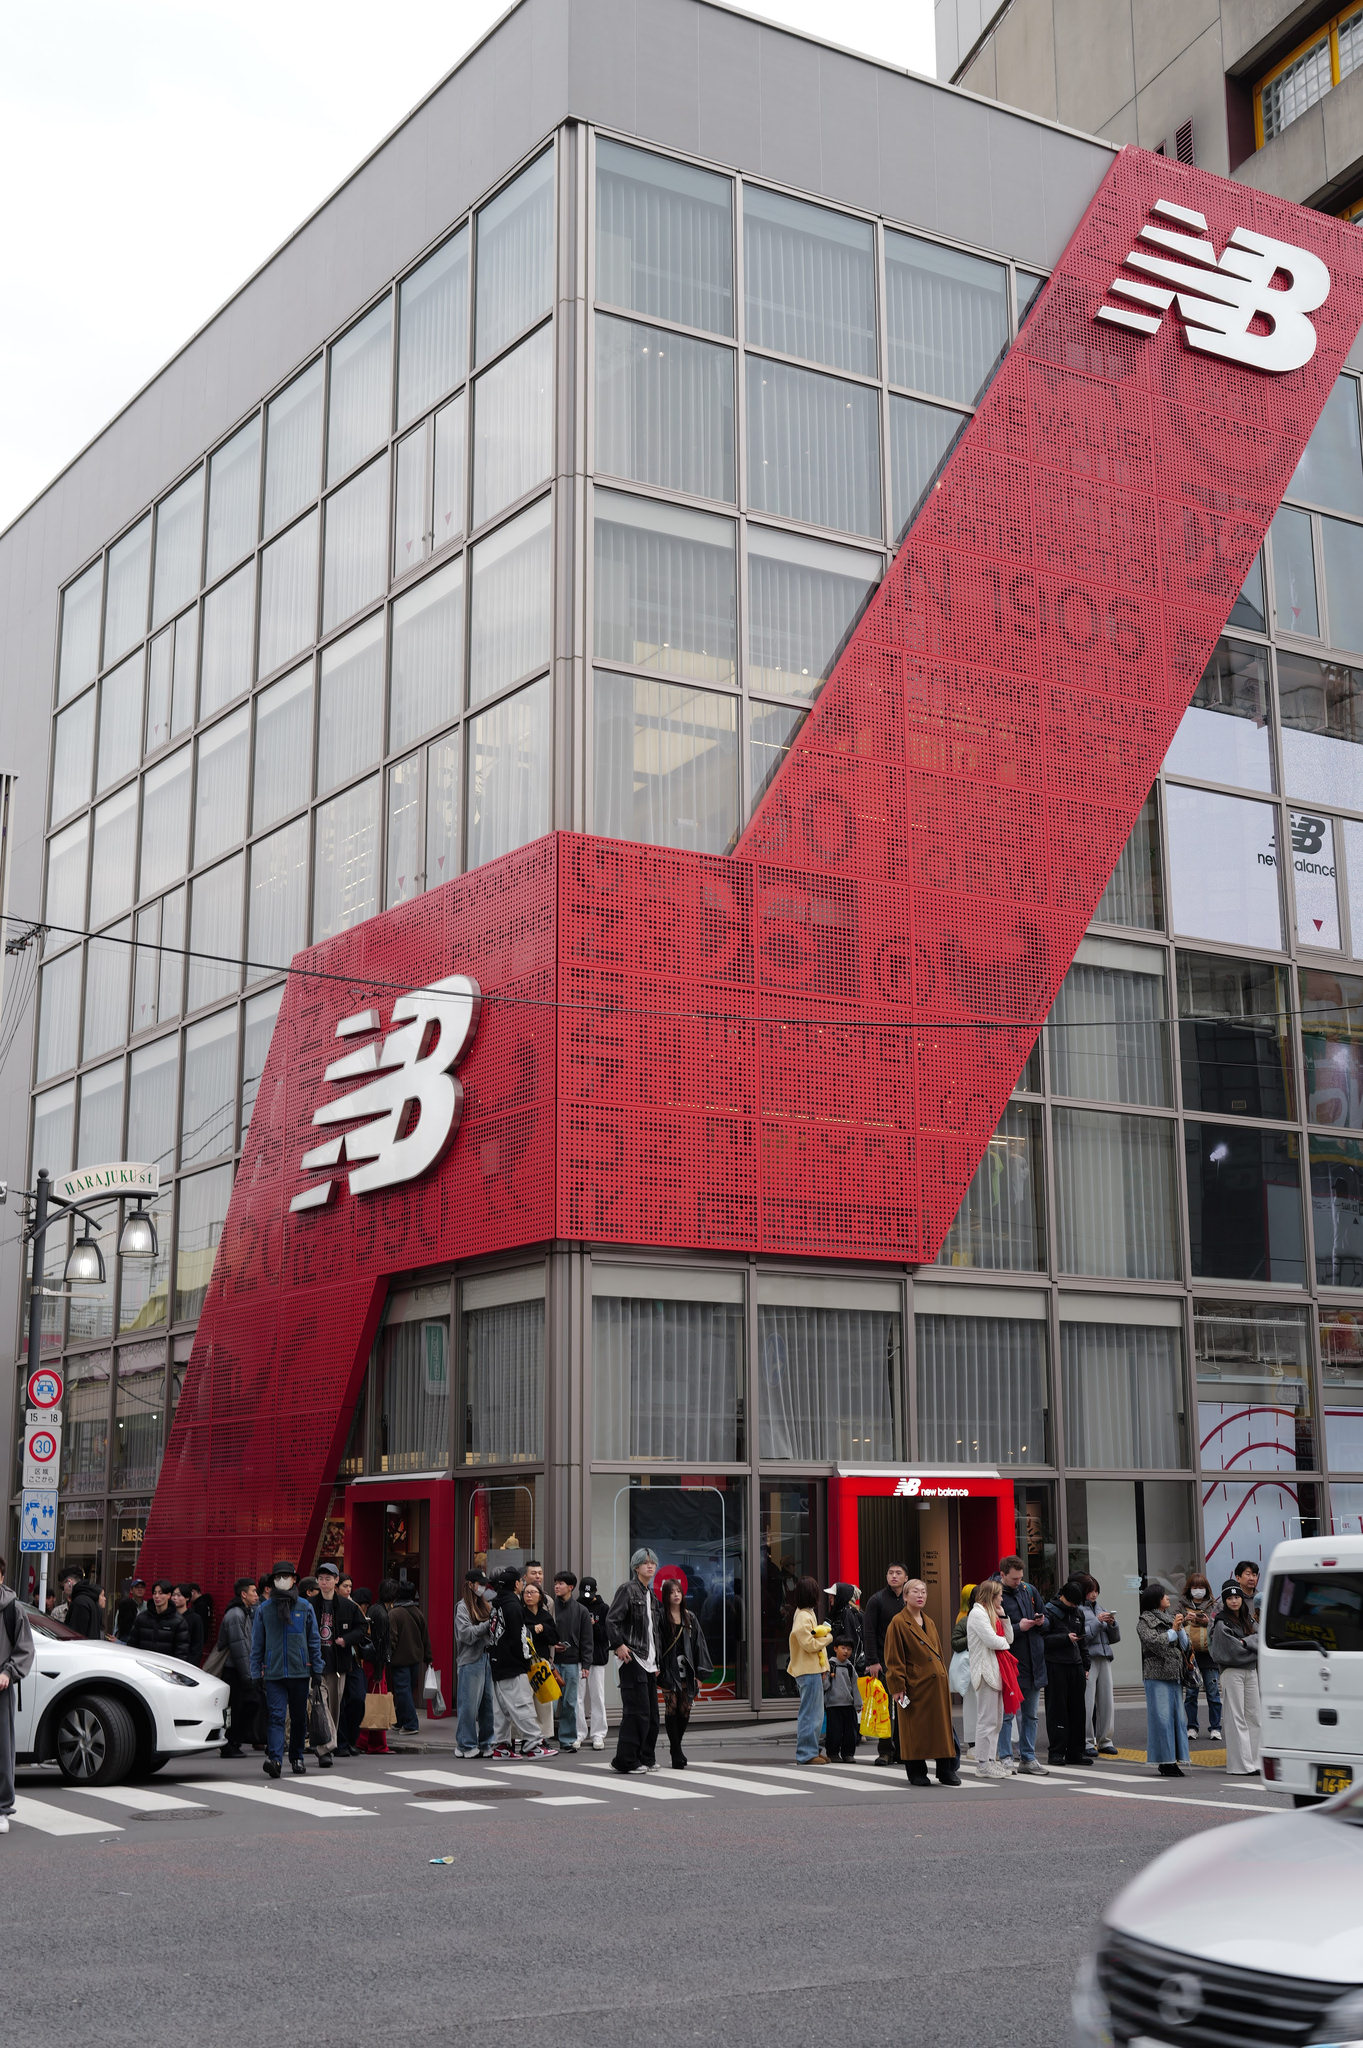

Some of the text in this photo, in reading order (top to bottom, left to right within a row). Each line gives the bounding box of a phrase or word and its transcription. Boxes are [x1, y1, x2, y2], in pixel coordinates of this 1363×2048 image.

[30, 1413, 38, 1422] 15
[50, 1413, 58, 1423] 18
[35, 1439, 51, 1454] 30
[921, 1488, 936, 1497] new
[937, 1487, 969, 1497] balance
